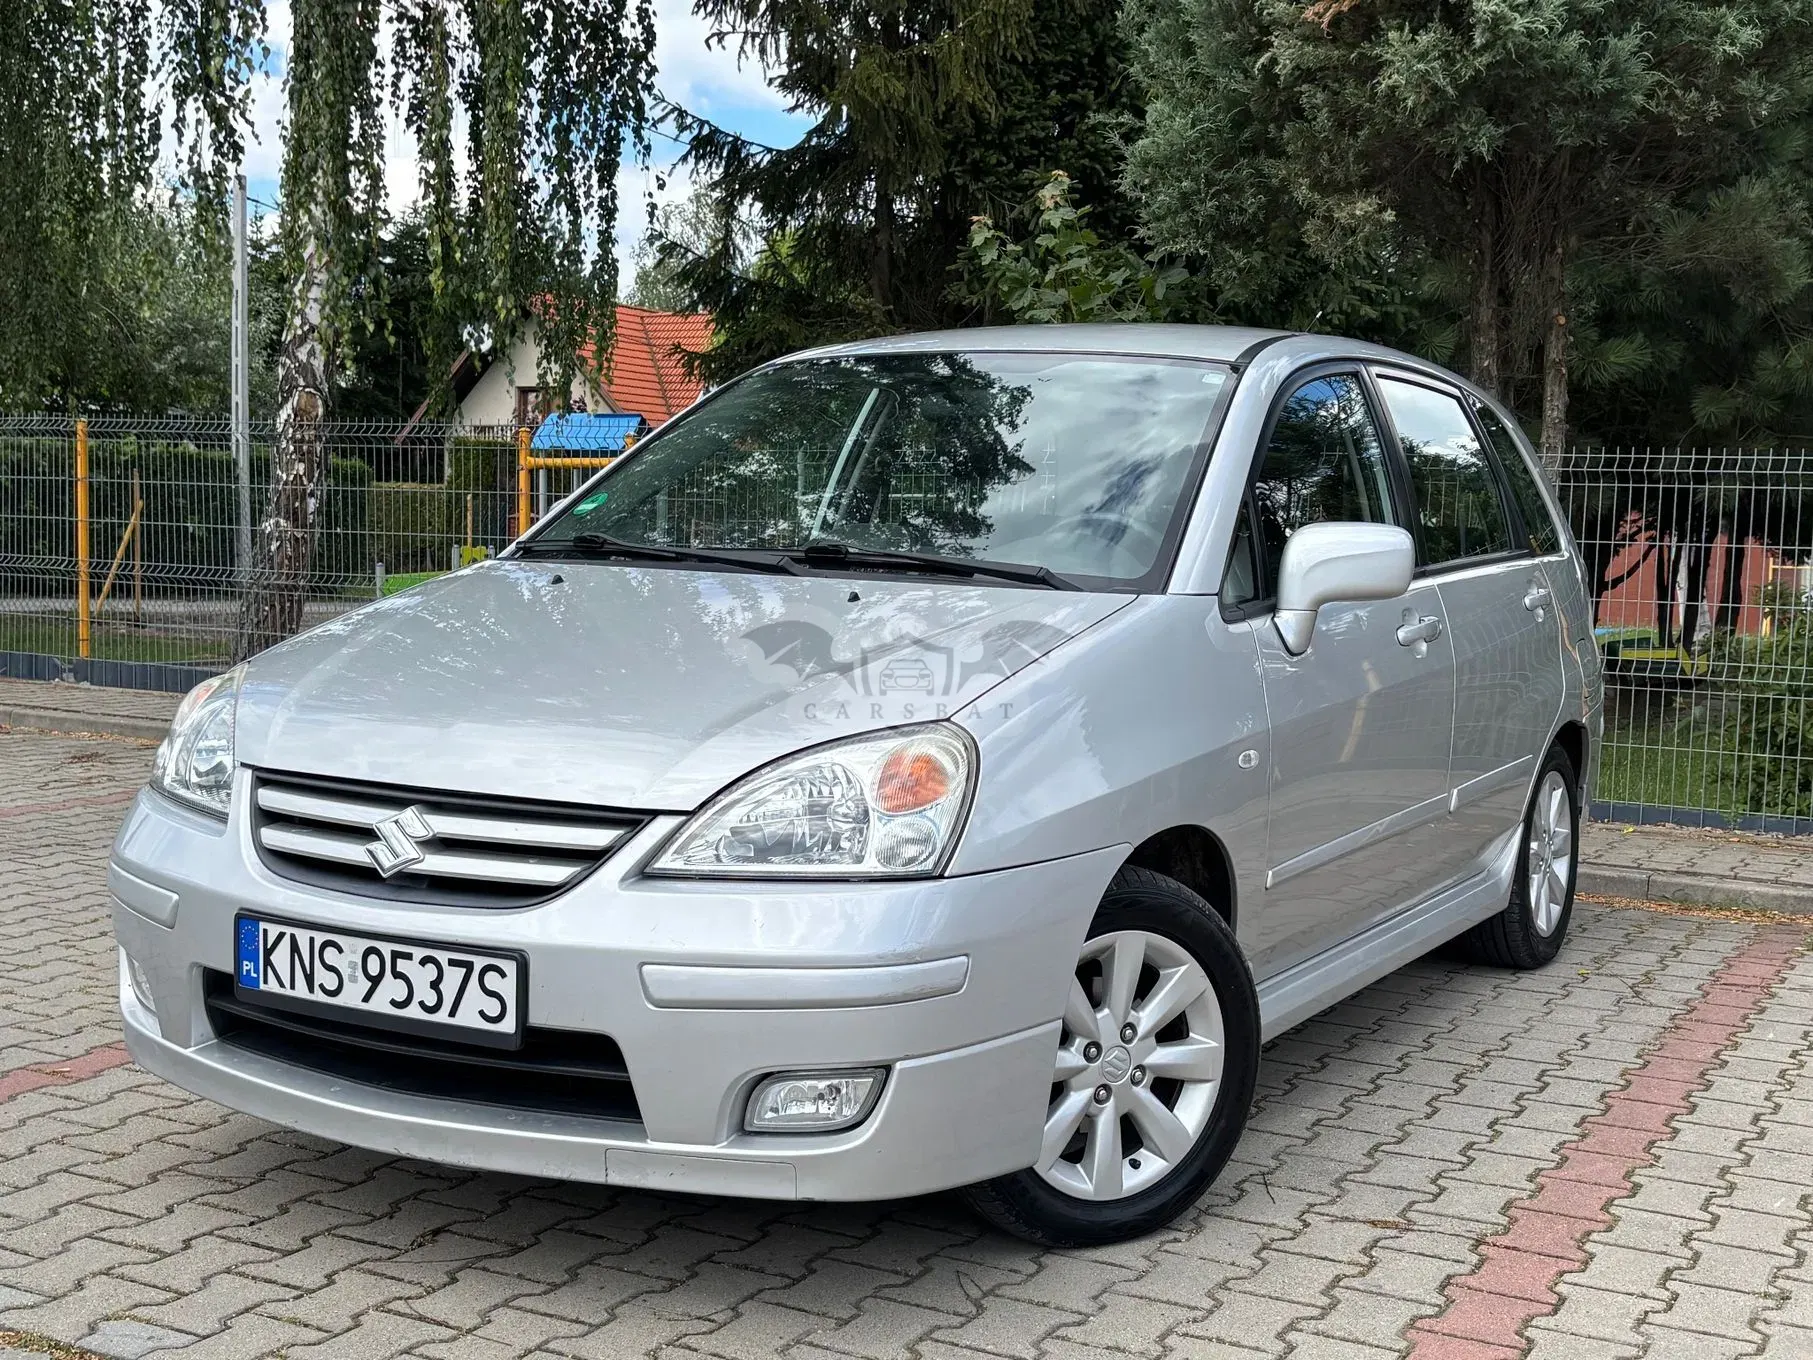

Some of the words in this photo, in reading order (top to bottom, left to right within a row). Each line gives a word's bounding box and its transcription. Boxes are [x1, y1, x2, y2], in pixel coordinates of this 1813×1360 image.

[243, 961, 258, 978] PL
[262, 928, 344, 997] KNS
[361, 946, 508, 1024] 9537S
